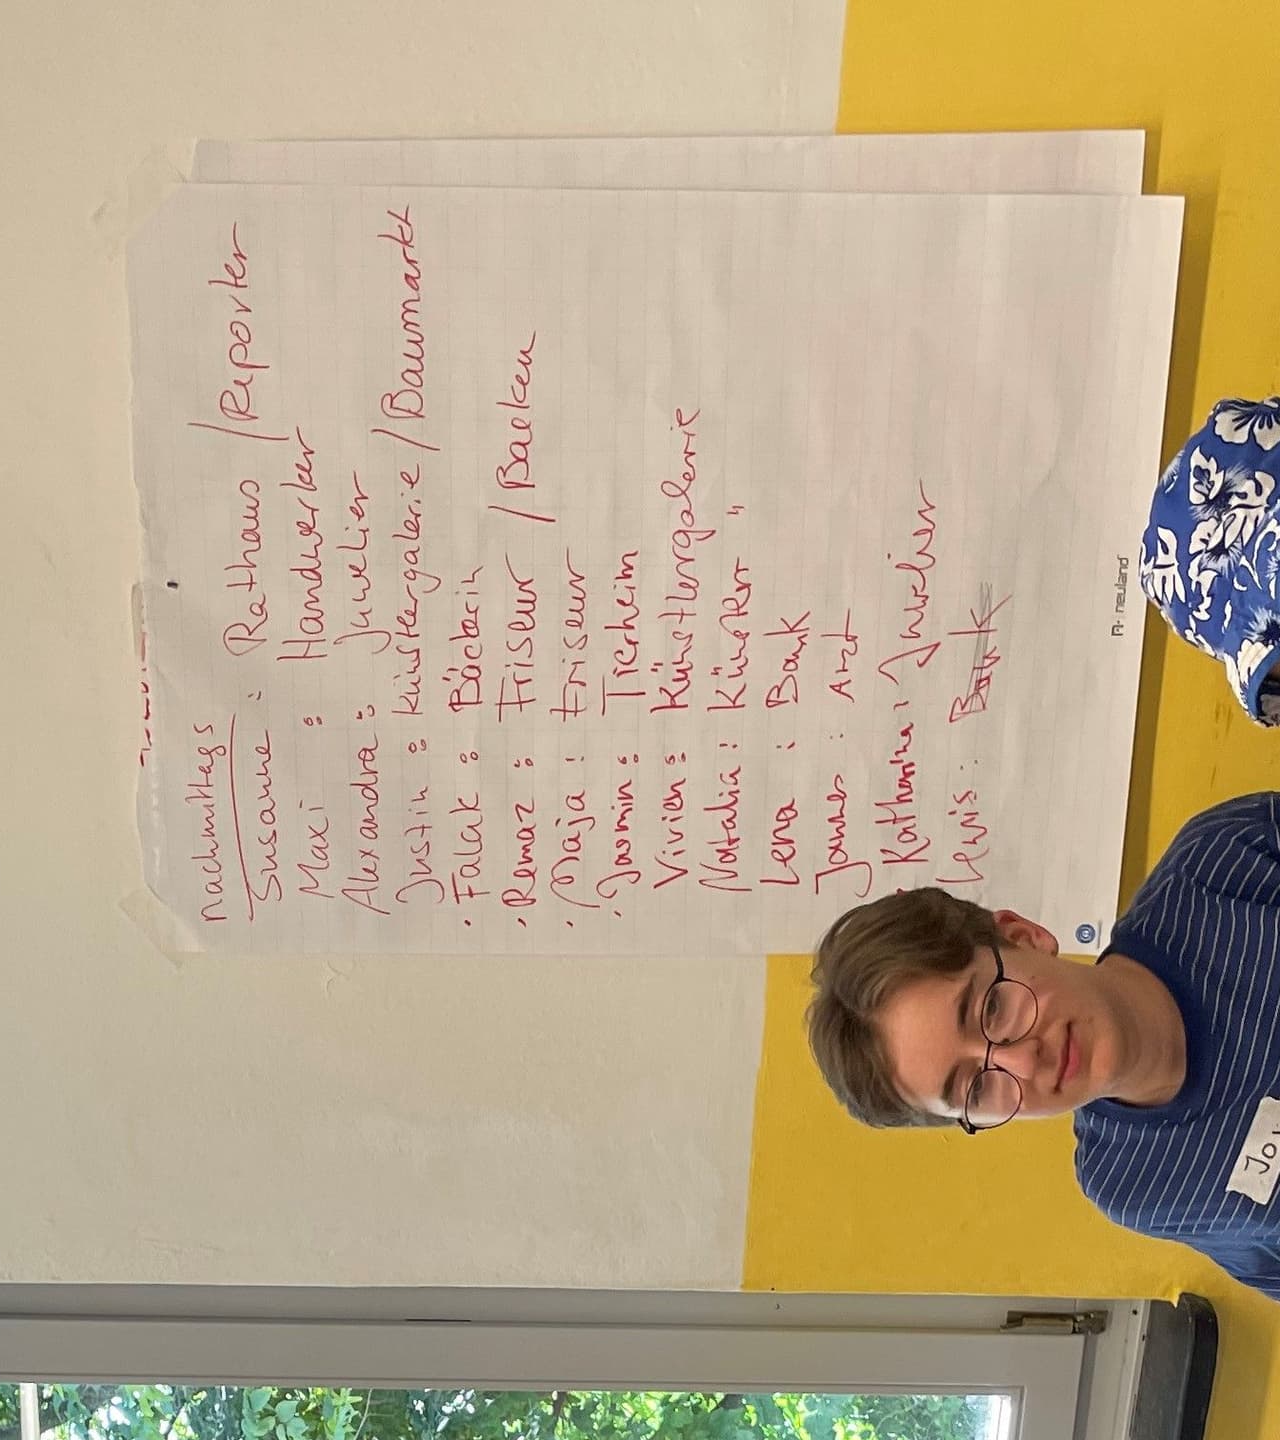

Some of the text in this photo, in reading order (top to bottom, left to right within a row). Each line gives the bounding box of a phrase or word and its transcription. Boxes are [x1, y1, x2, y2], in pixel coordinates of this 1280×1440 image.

[223, 480, 267, 656] Rathaus
[277, 426, 327, 660] Handwerker
[333, 471, 391, 654] Juwelier
[1114, 554, 1129, 613] neuland
[442, 566, 484, 712] Bäckerin
[495, 551, 537, 723] Friseur
[549, 548, 588, 721] Friseur
[601, 550, 645, 717] Tierheim
[763, 610, 810, 707] Bank
[297, 800, 334, 899] Maxi
[396, 786, 445, 904] Justin
[449, 791, 490, 905] Falak
[500, 796, 536, 907] Remaz
[550, 790, 600, 908] Maja
[759, 800, 799, 885] Lena
